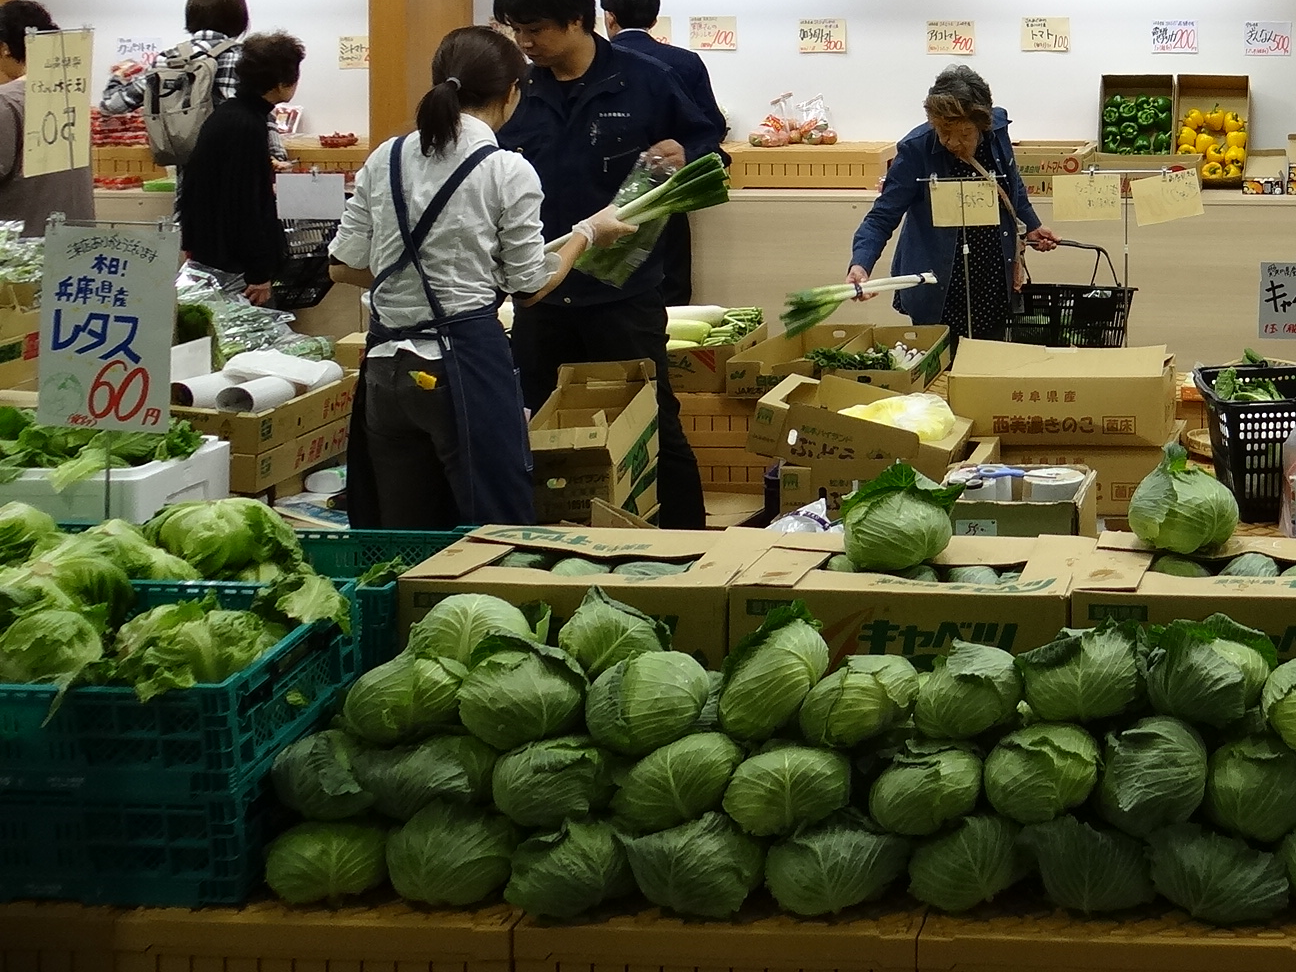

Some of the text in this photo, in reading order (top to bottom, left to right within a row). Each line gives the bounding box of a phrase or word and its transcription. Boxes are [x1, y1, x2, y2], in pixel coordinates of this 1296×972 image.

[1031, 29, 1053, 41] トマト
[1246, 27, 1273, 45] ぎんなん
[91, 254, 129, 277] 本日!
[54, 276, 130, 308] 兵庫県産
[51, 308, 143, 365] レタス
[1012, 390, 1077, 403] 岐阜県産
[992, 415, 1095, 435] 西美濃きのこ
[1103, 417, 1135, 433] 菌床
[857, 619, 1019, 656] キャベツ
